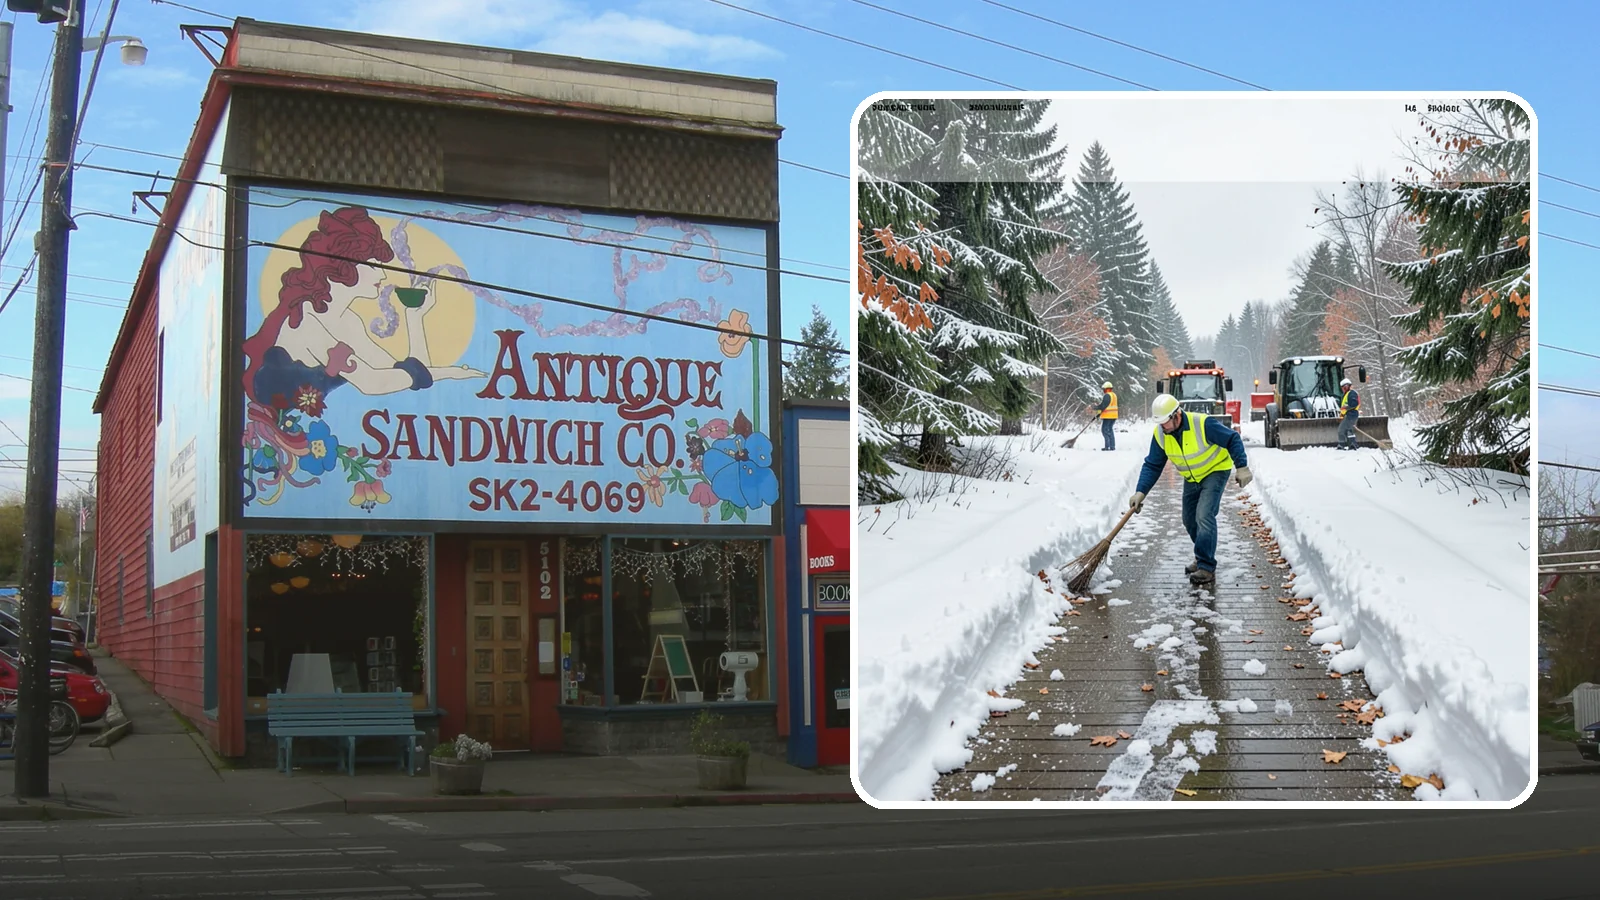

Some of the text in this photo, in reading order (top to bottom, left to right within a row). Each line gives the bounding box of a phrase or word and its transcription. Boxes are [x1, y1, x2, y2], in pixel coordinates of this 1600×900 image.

[476, 328, 724, 422] ANTIQUE
[361, 408, 685, 469] SANDWICH CO.
[469, 477, 645, 513] SK2-4069
[540, 541, 551, 600] 5102
[809, 555, 835, 569] BOOKS
